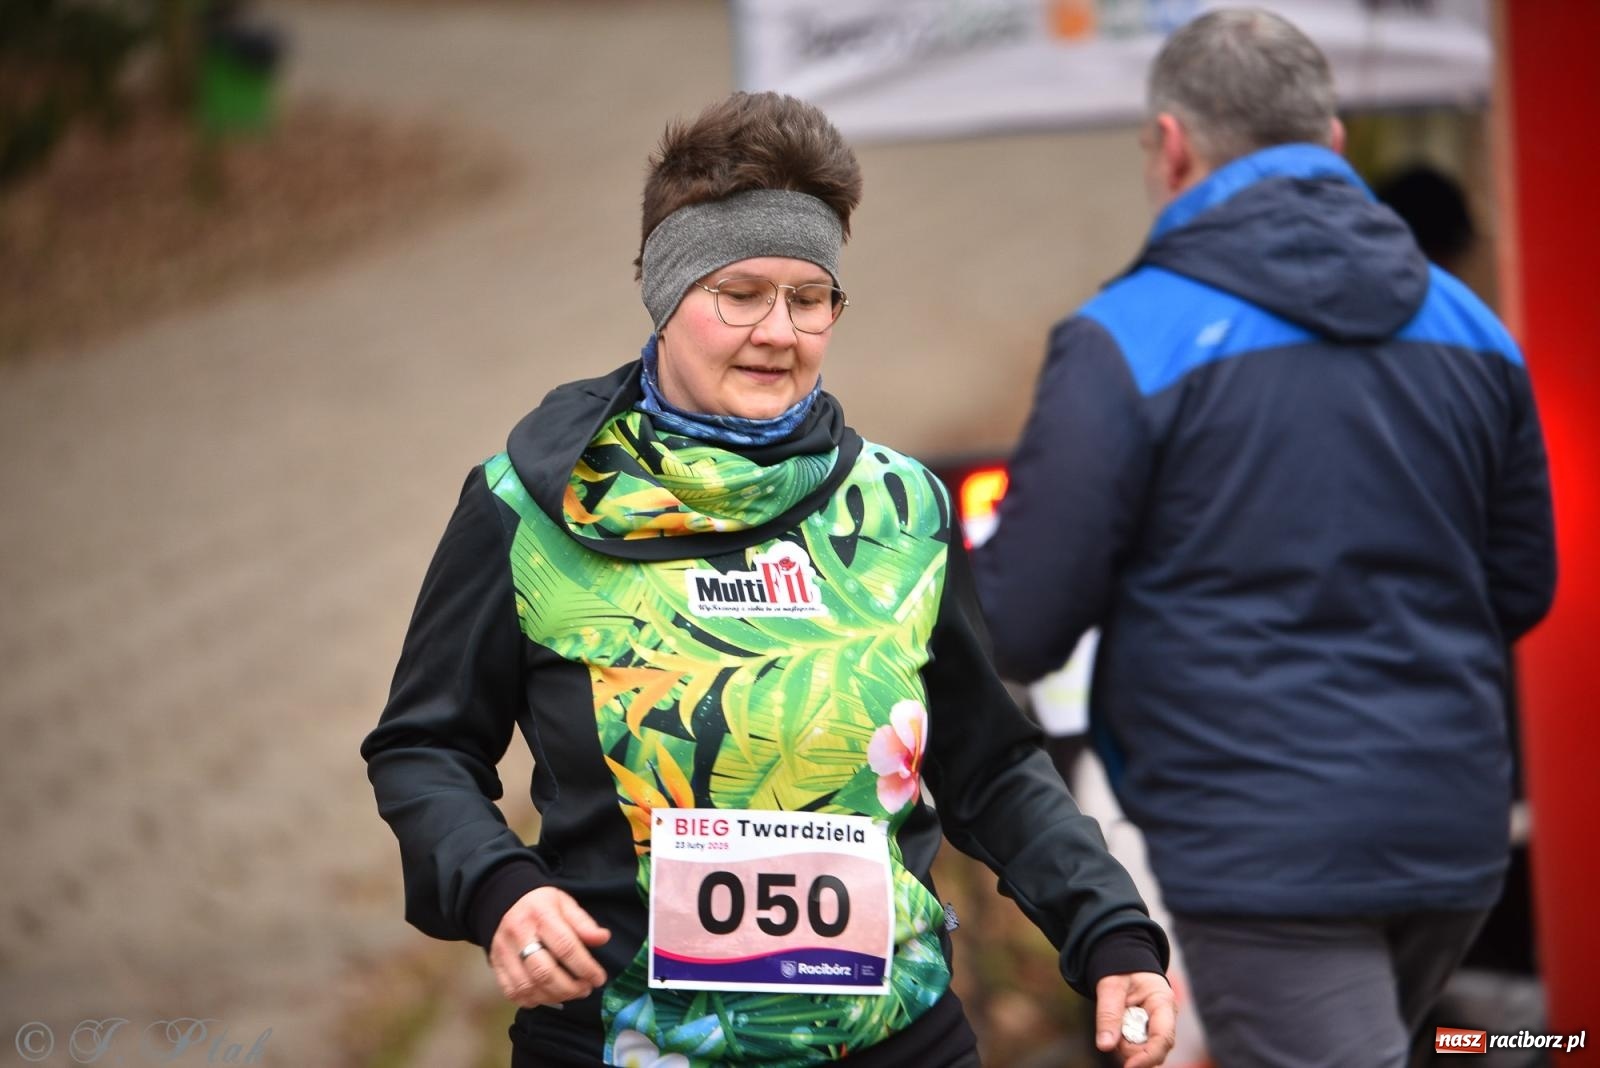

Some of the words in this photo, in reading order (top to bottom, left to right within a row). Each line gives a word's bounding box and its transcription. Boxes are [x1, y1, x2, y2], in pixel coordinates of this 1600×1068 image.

[675, 818, 730, 837] BIEG
[737, 819, 866, 844] Twardziela
[675, 841, 685, 849] 23
[686, 841, 705, 851] luty
[697, 870, 851, 938] 050
[798, 961, 852, 976] Racibórz
